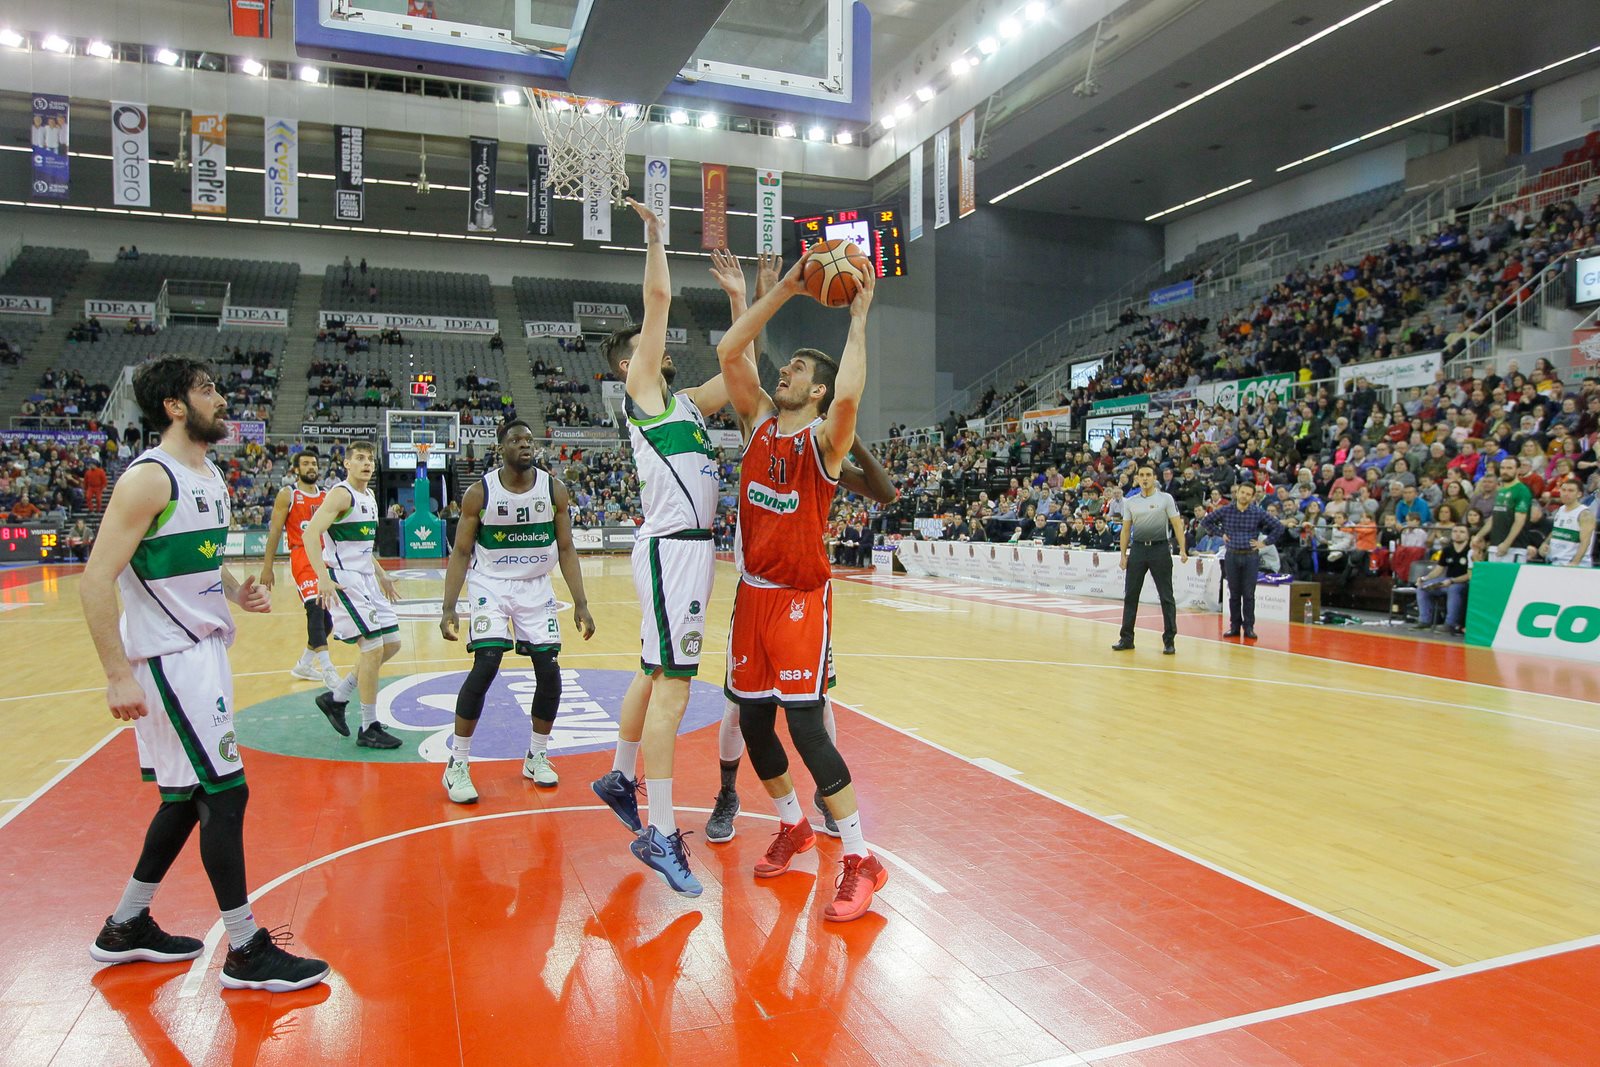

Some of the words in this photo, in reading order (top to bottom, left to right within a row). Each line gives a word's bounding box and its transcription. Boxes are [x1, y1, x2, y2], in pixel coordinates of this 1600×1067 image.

[351, 127, 363, 186] BURGERS
[122, 140, 145, 202] otero
[198, 159, 224, 203] enPie
[268, 141, 293, 215] cvglass
[718, 193, 726, 247] ANTONIO
[762, 190, 776, 252] fertisac
[880, 211, 893, 222] 32
[806, 221, 819, 231] 45
[88, 302, 153, 315] IDEAL
[225, 308, 285, 321] IDEAL
[577, 304, 624, 315] IDEAL
[322, 313, 379, 326] IDEAL
[384, 316, 437, 329] IDEAL
[443, 319, 495, 331] IDEAL
[530, 323, 578, 334] IDEAL
[516, 506, 530, 523] 21
[41, 534, 57, 547] 32
[507, 531, 550, 543] Globalcaja
[492, 554, 548, 565] ARCOS
[685, 640, 699, 653] AB
